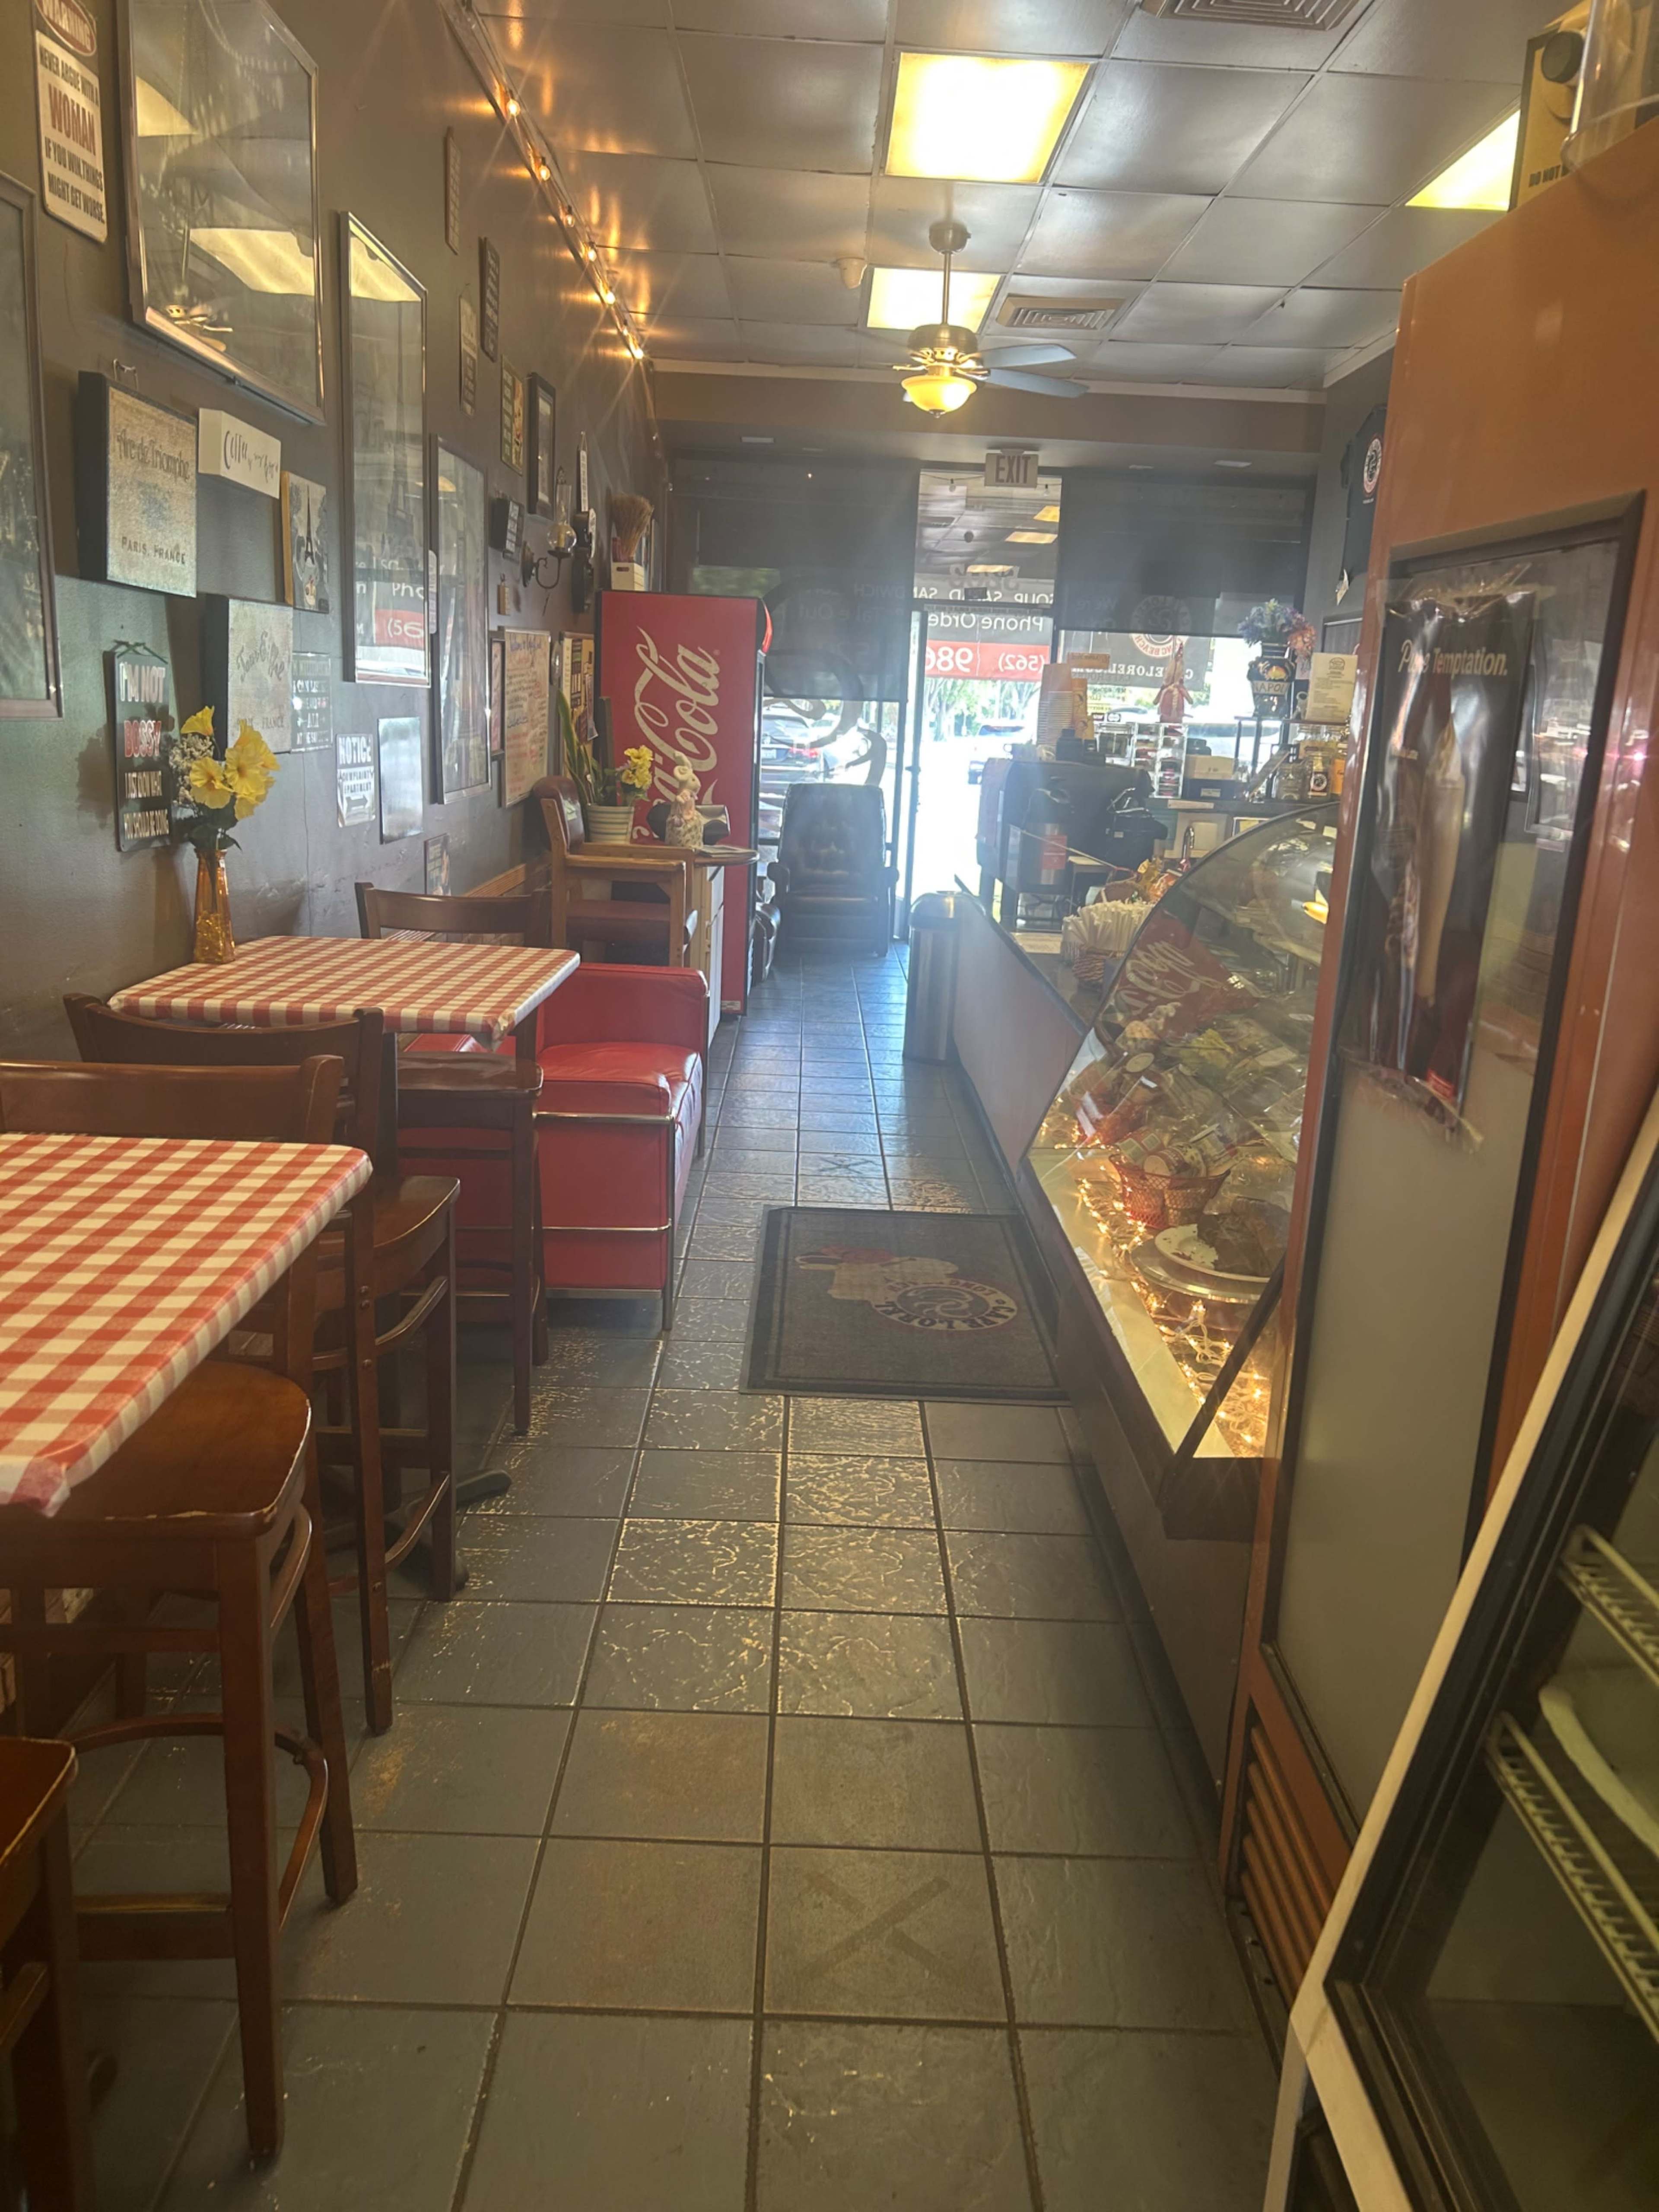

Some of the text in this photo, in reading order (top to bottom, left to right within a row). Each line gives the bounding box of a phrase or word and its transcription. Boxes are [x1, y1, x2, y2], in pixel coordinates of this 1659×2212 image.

[40, 45, 60, 77] NEVER
[61, 60, 80, 93] ARGUE
[48, 83, 96, 156] WOMAN
[44, 136, 51, 159] IF
[52, 140, 67, 168] YOU
[82, 159, 103, 192] THINGS
[48, 171, 70, 203] MIGHT
[70, 184, 82, 210] GET
[117, 429, 136, 460] Arc
[137, 436, 150, 464] de
[995, 455, 1031, 483] EXIT
[153, 544, 186, 565] FRANCE
[119, 661, 165, 703] I'M NOT
[1433, 647, 1508, 680] Temptation.
[124, 719, 162, 758] BOSSY
[338, 736, 372, 765] NOTICE
